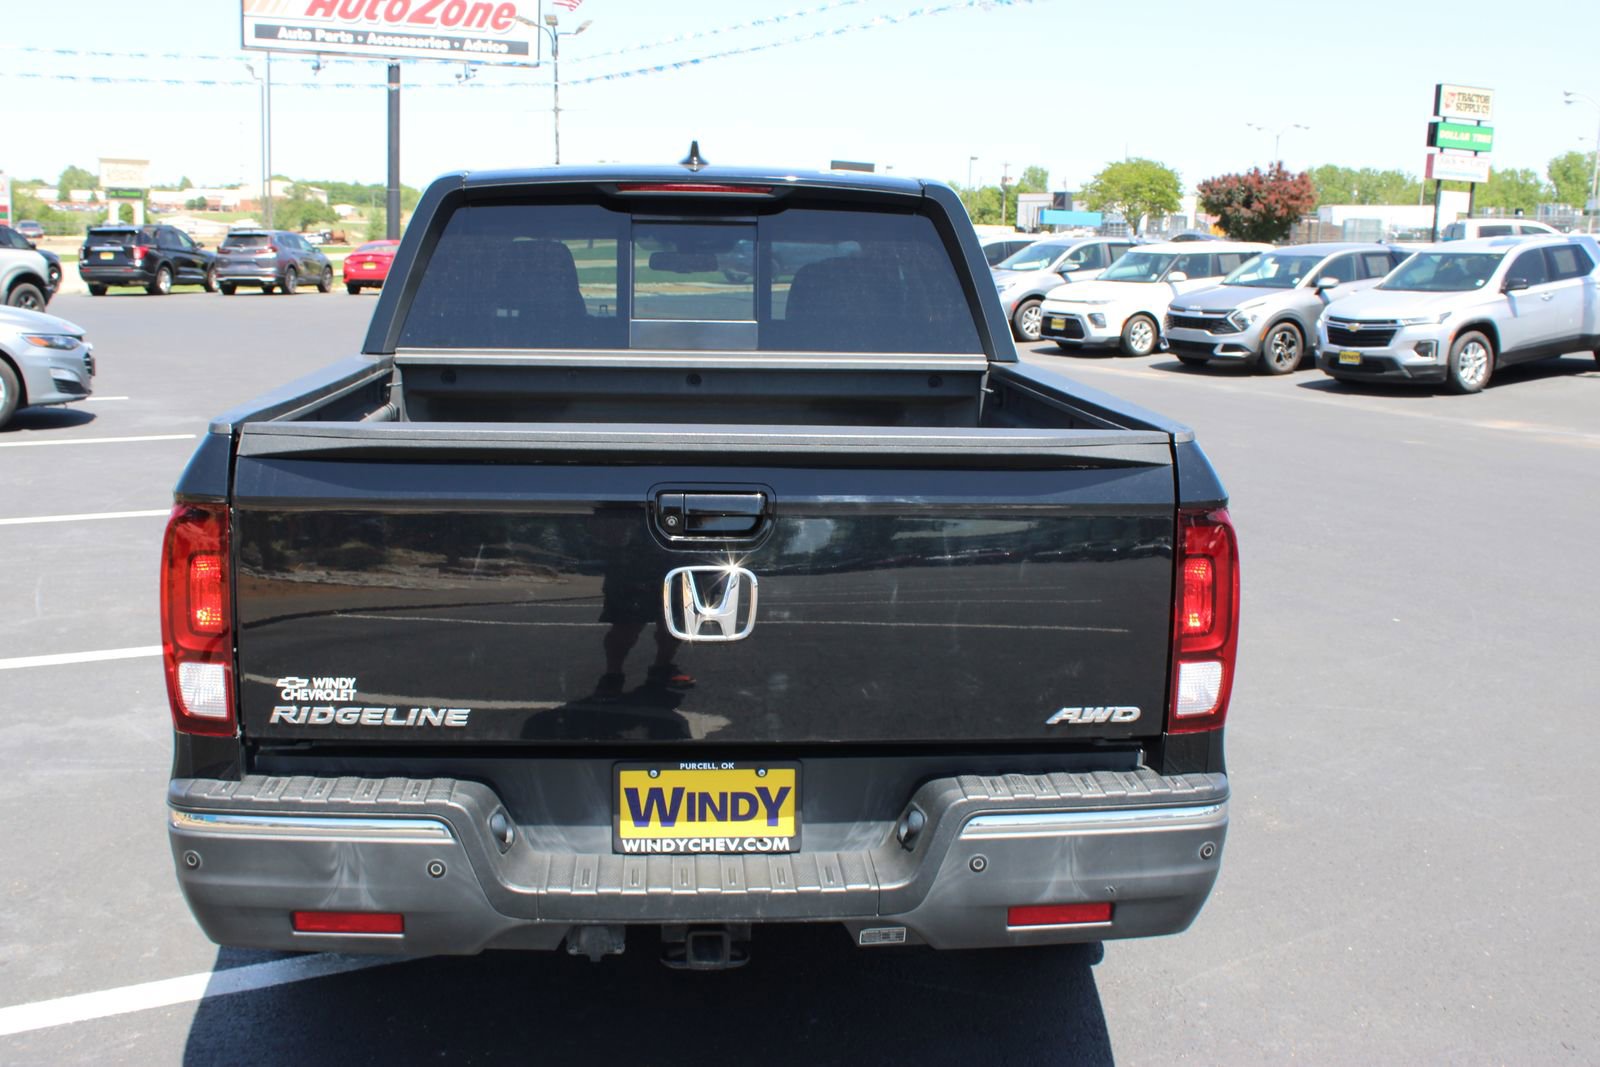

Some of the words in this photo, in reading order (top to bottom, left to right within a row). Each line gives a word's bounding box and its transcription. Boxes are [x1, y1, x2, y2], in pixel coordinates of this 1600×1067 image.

[277, 26, 312, 40] Auto
[315, 28, 354, 43] Parts
[366, 31, 451, 49] Accessories
[463, 39, 509, 53] Advice
[1457, 92, 1490, 104] TRACTOR
[312, 677, 357, 689] WINDY
[280, 689, 357, 702] CHEVROLET
[269, 705, 471, 727] RIDGELINE
[1046, 706, 1141, 724] AWD
[679, 762, 719, 770] PURCELL,
[622, 837, 790, 852] WINDYCHEV.COM
